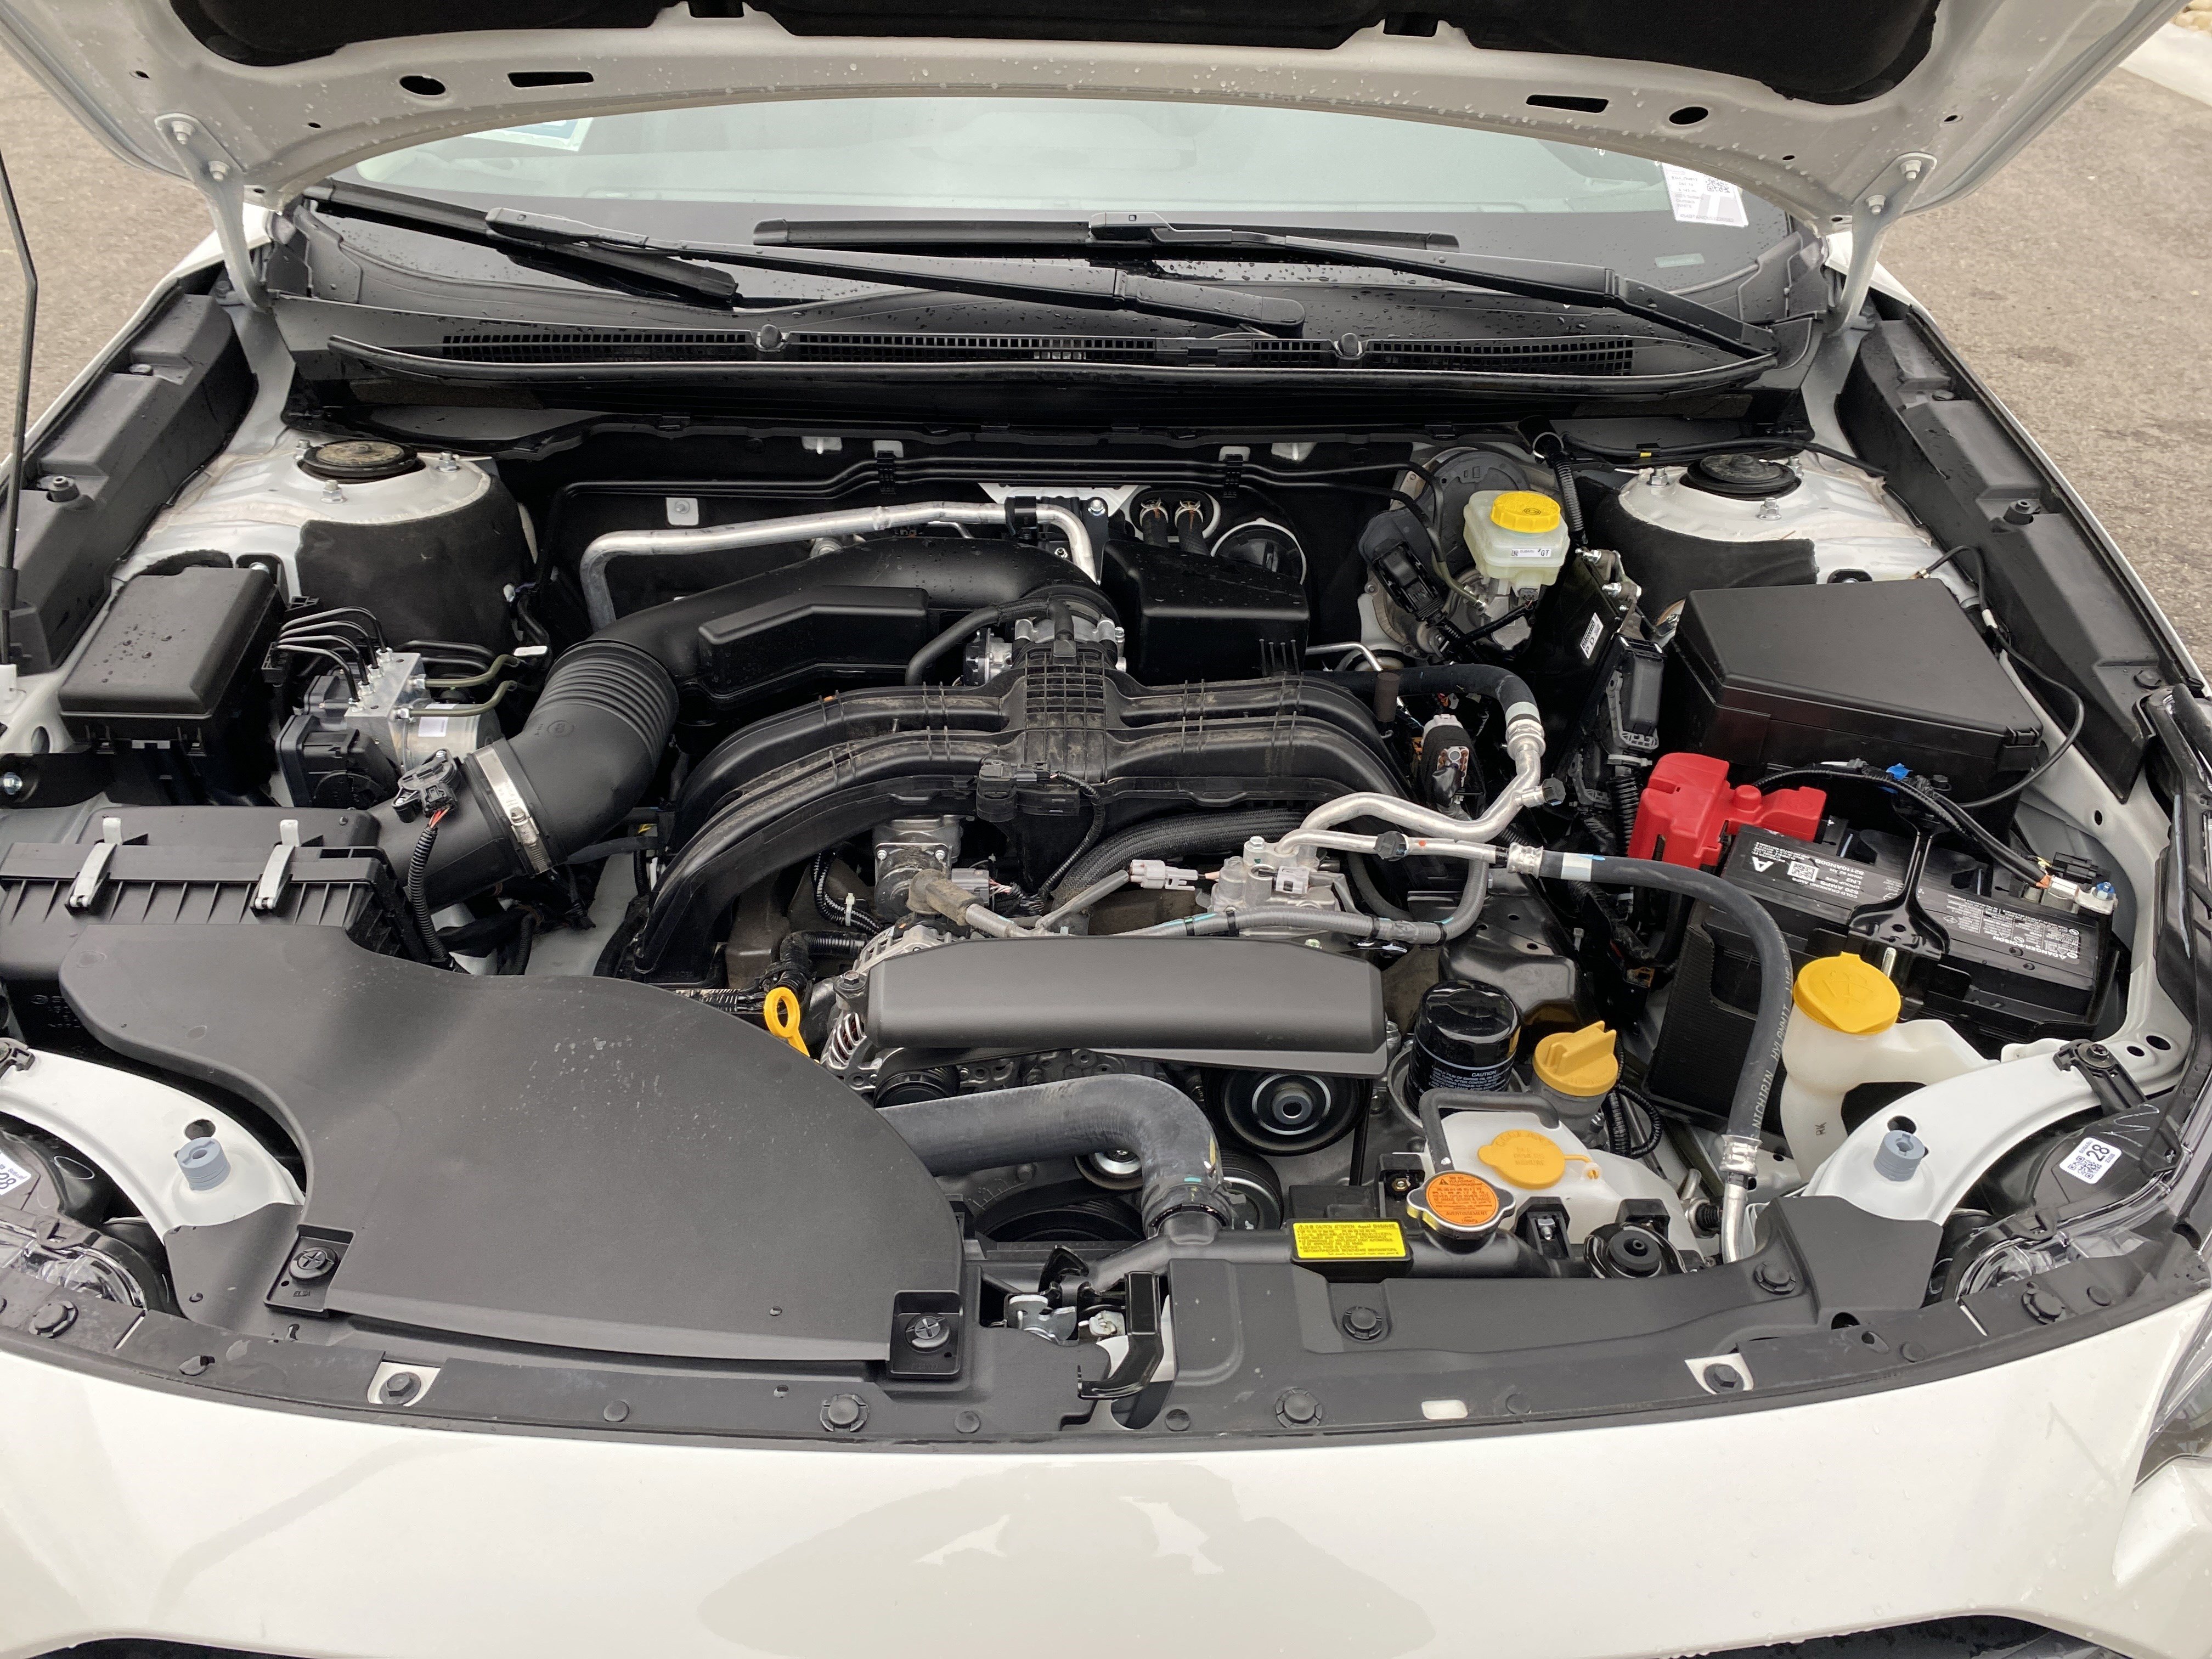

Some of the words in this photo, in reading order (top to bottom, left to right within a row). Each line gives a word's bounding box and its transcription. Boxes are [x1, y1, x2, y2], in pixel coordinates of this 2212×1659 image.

[1809, 882, 1839, 894] CRANKING
[1820, 881, 1843, 890] AMPS
[1752, 1069, 1773, 1128] NICHIRIN
[2086, 1144, 2110, 1162] 28
